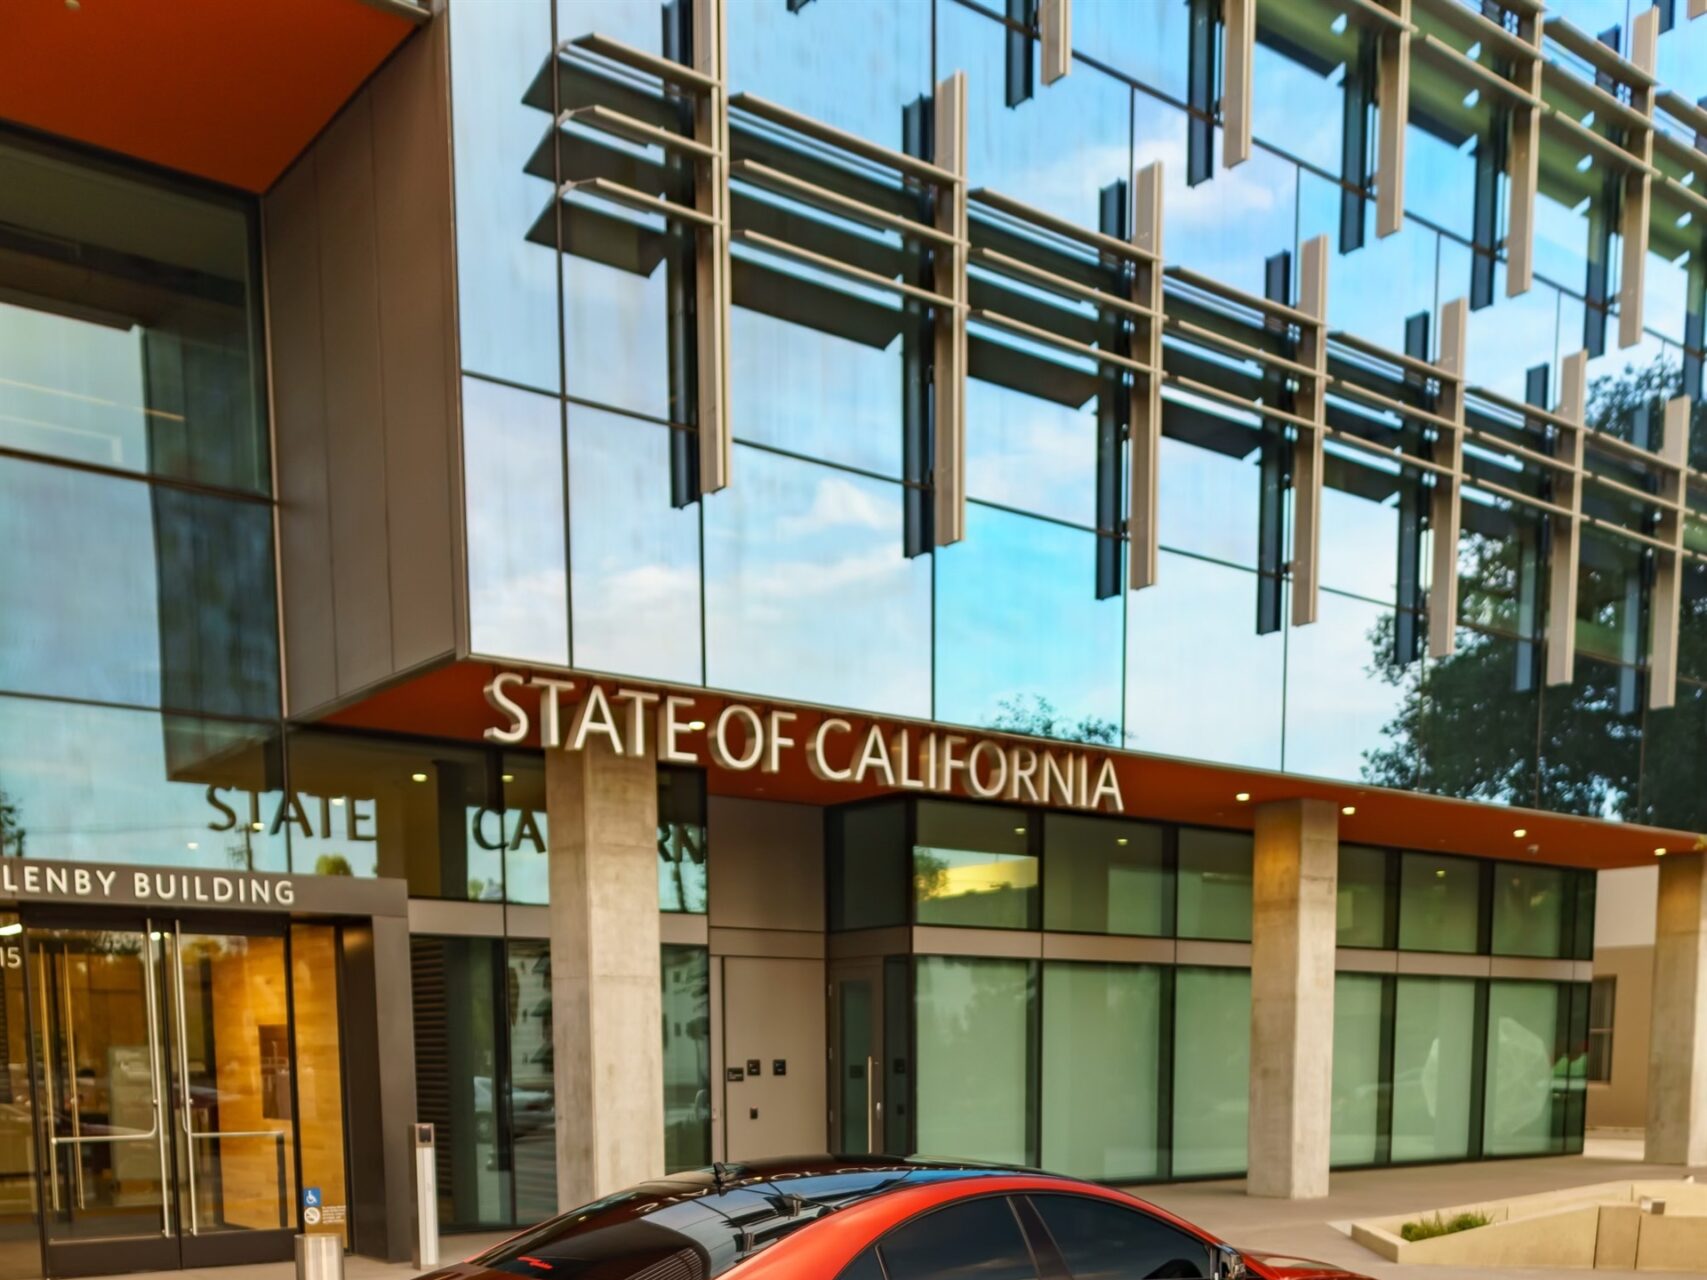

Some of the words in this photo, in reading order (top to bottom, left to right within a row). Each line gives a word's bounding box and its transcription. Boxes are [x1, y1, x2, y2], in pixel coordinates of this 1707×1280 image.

[485, 671, 699, 763] STATE
[709, 703, 797, 774] OF
[807, 717, 1125, 813] CALIFORNIA
[2, 864, 117, 897] LENBY
[133, 872, 295, 905] BUILDING
